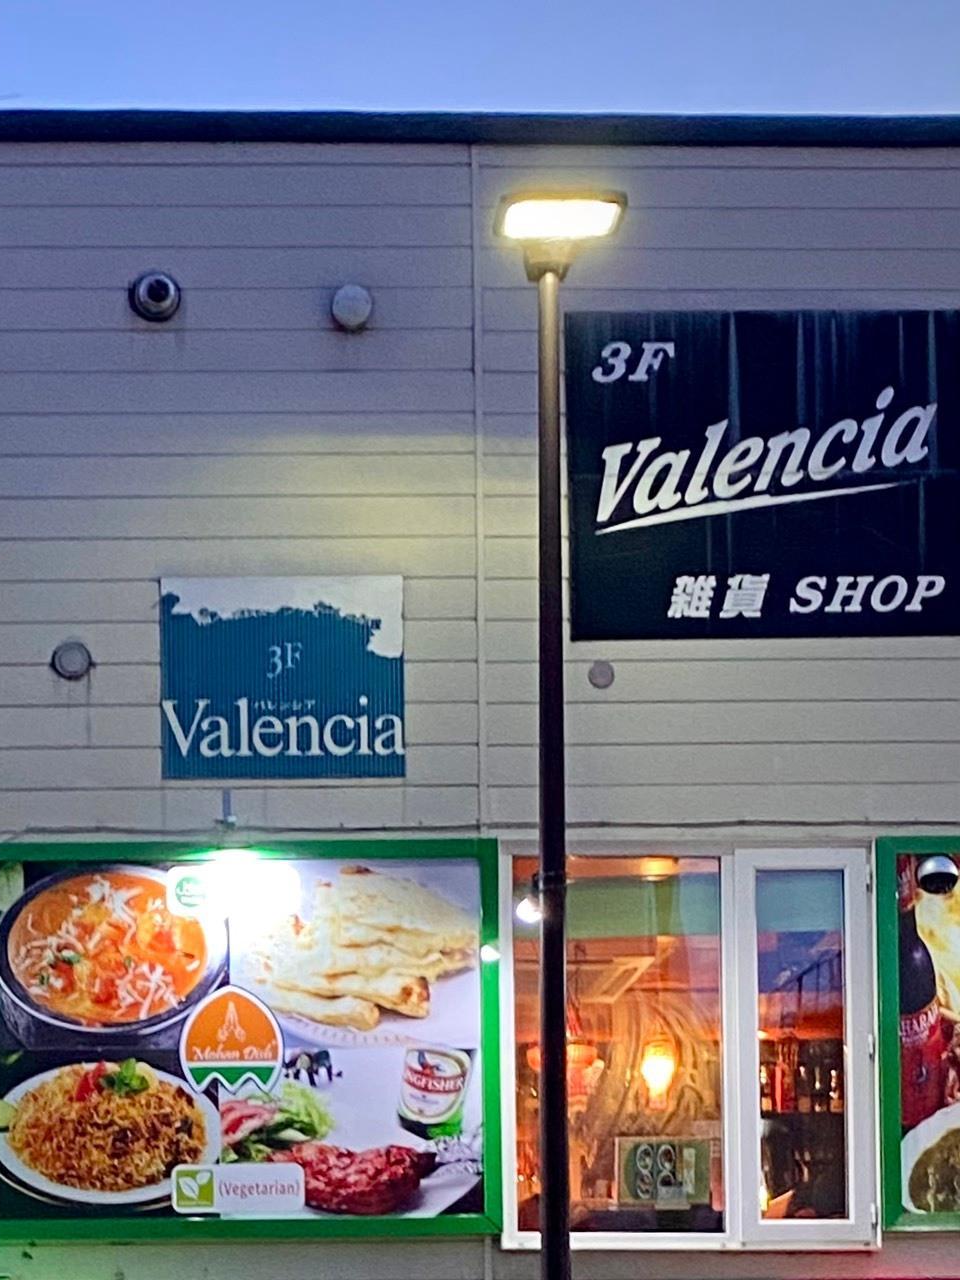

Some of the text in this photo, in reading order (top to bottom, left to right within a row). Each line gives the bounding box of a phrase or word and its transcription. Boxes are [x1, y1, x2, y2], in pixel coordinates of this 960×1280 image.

[592, 341, 675, 383] 3F
[596, 386, 938, 523] Valencia
[667, 574, 945, 618] 雑貨 SHOP
[266, 642, 303, 679] 3F
[161, 695, 406, 758] Valencia
[218, 1179, 300, 1199] (Vegetarian)
